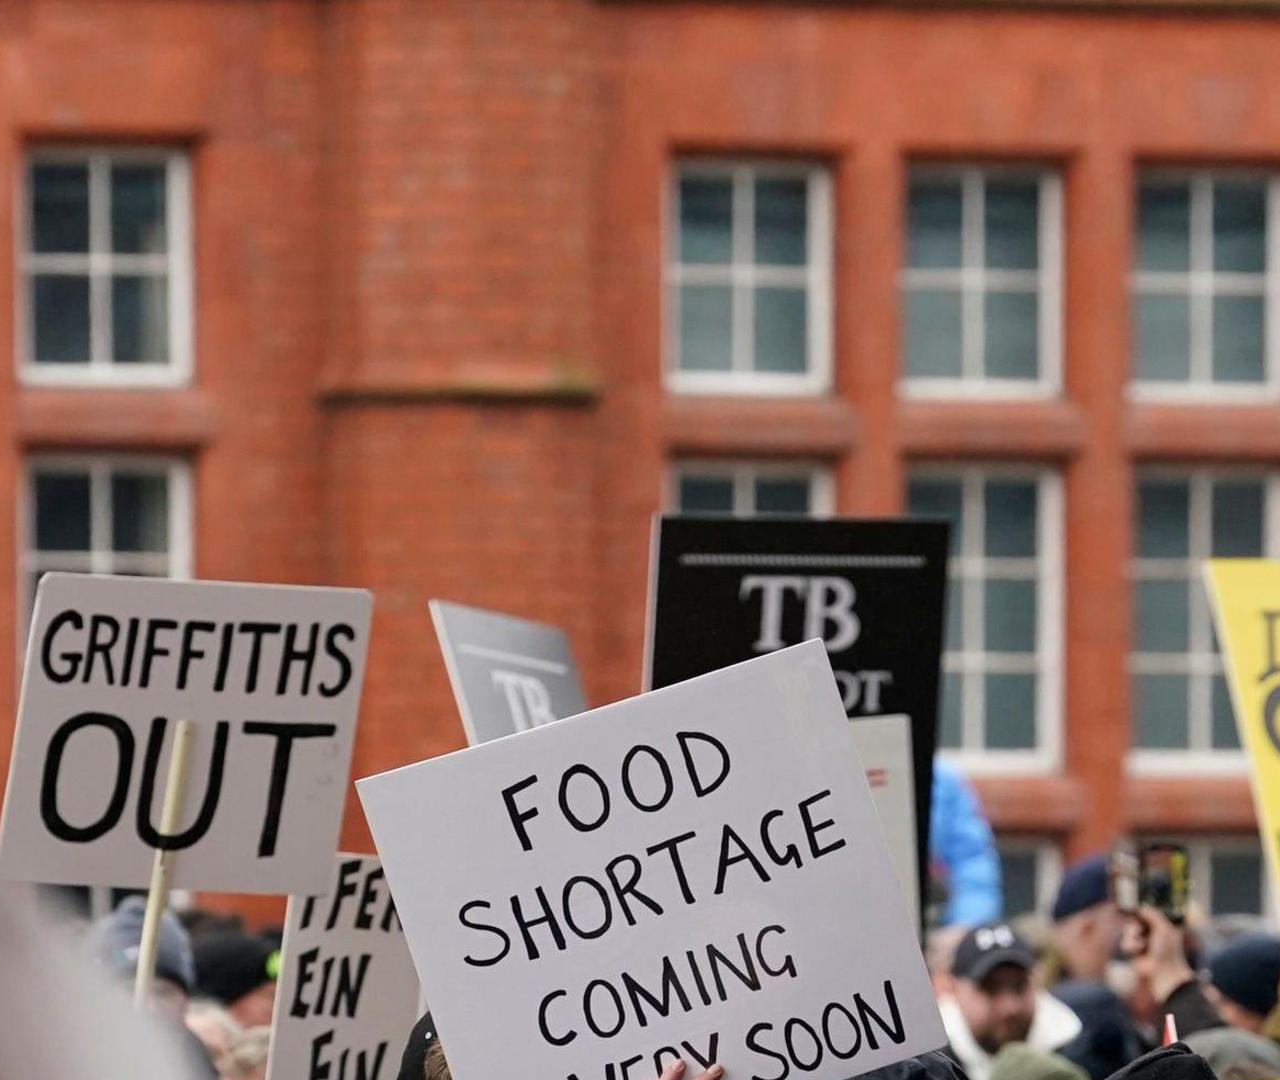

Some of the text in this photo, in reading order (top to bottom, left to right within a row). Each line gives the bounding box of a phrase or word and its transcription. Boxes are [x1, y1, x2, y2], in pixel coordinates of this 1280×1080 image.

[40, 609, 356, 699] GRIFFITHS
[740, 574, 861, 652] TB
[39, 711, 338, 859] OUT
[501, 731, 731, 852] FOOD
[462, 789, 847, 967] SHORTAGE
[289, 946, 373, 1018] EIN
[538, 924, 798, 1046] COMING
